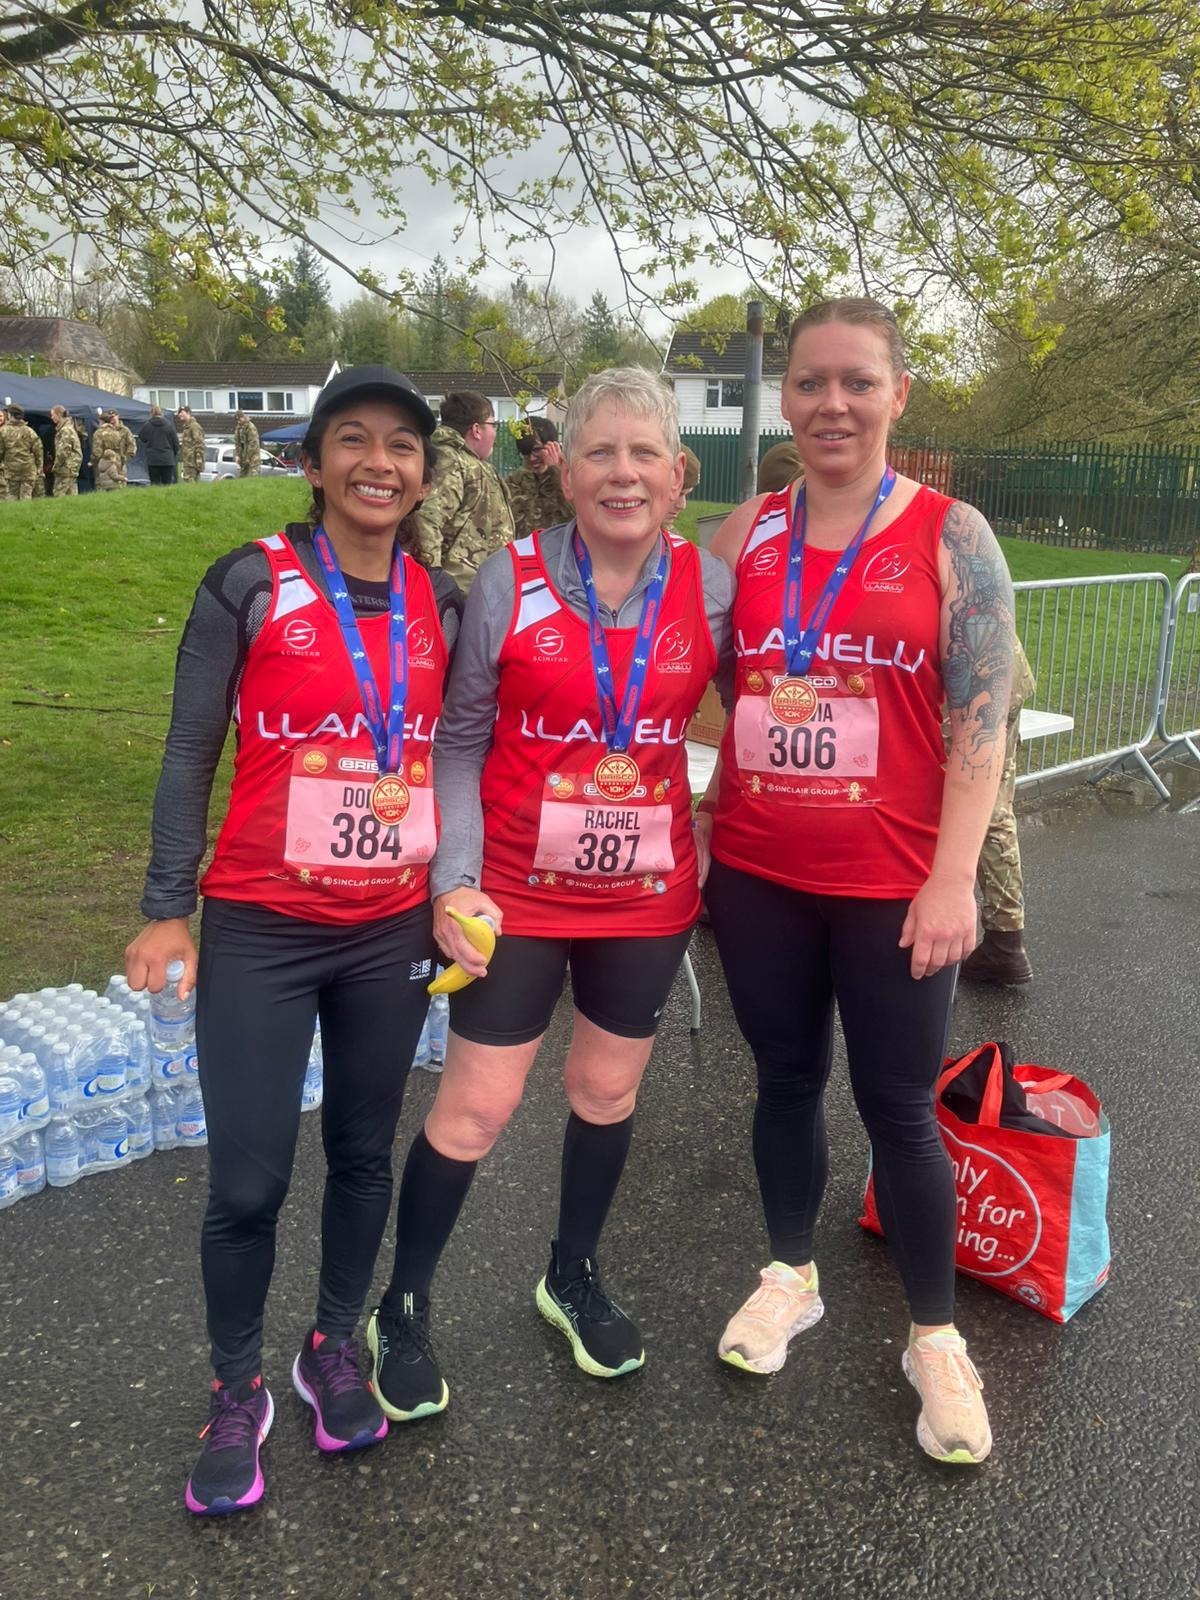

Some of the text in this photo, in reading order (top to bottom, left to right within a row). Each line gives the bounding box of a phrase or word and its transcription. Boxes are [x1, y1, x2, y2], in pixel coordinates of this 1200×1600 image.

[784, 710, 801, 718] 10K
[768, 725, 837, 770] 306
[609, 785, 625, 793] 10K
[774, 785, 809, 794] SINCLAIR
[810, 786, 839, 795] GROUP
[584, 809, 641, 830] RACHEL
[330, 813, 402, 861] 384
[574, 833, 641, 873] 387
[333, 877, 395, 887] SINCLAIR GROUP
[575, 880, 636, 889] SINCLAIR GROUP
[977, 1195, 1026, 1229] for
